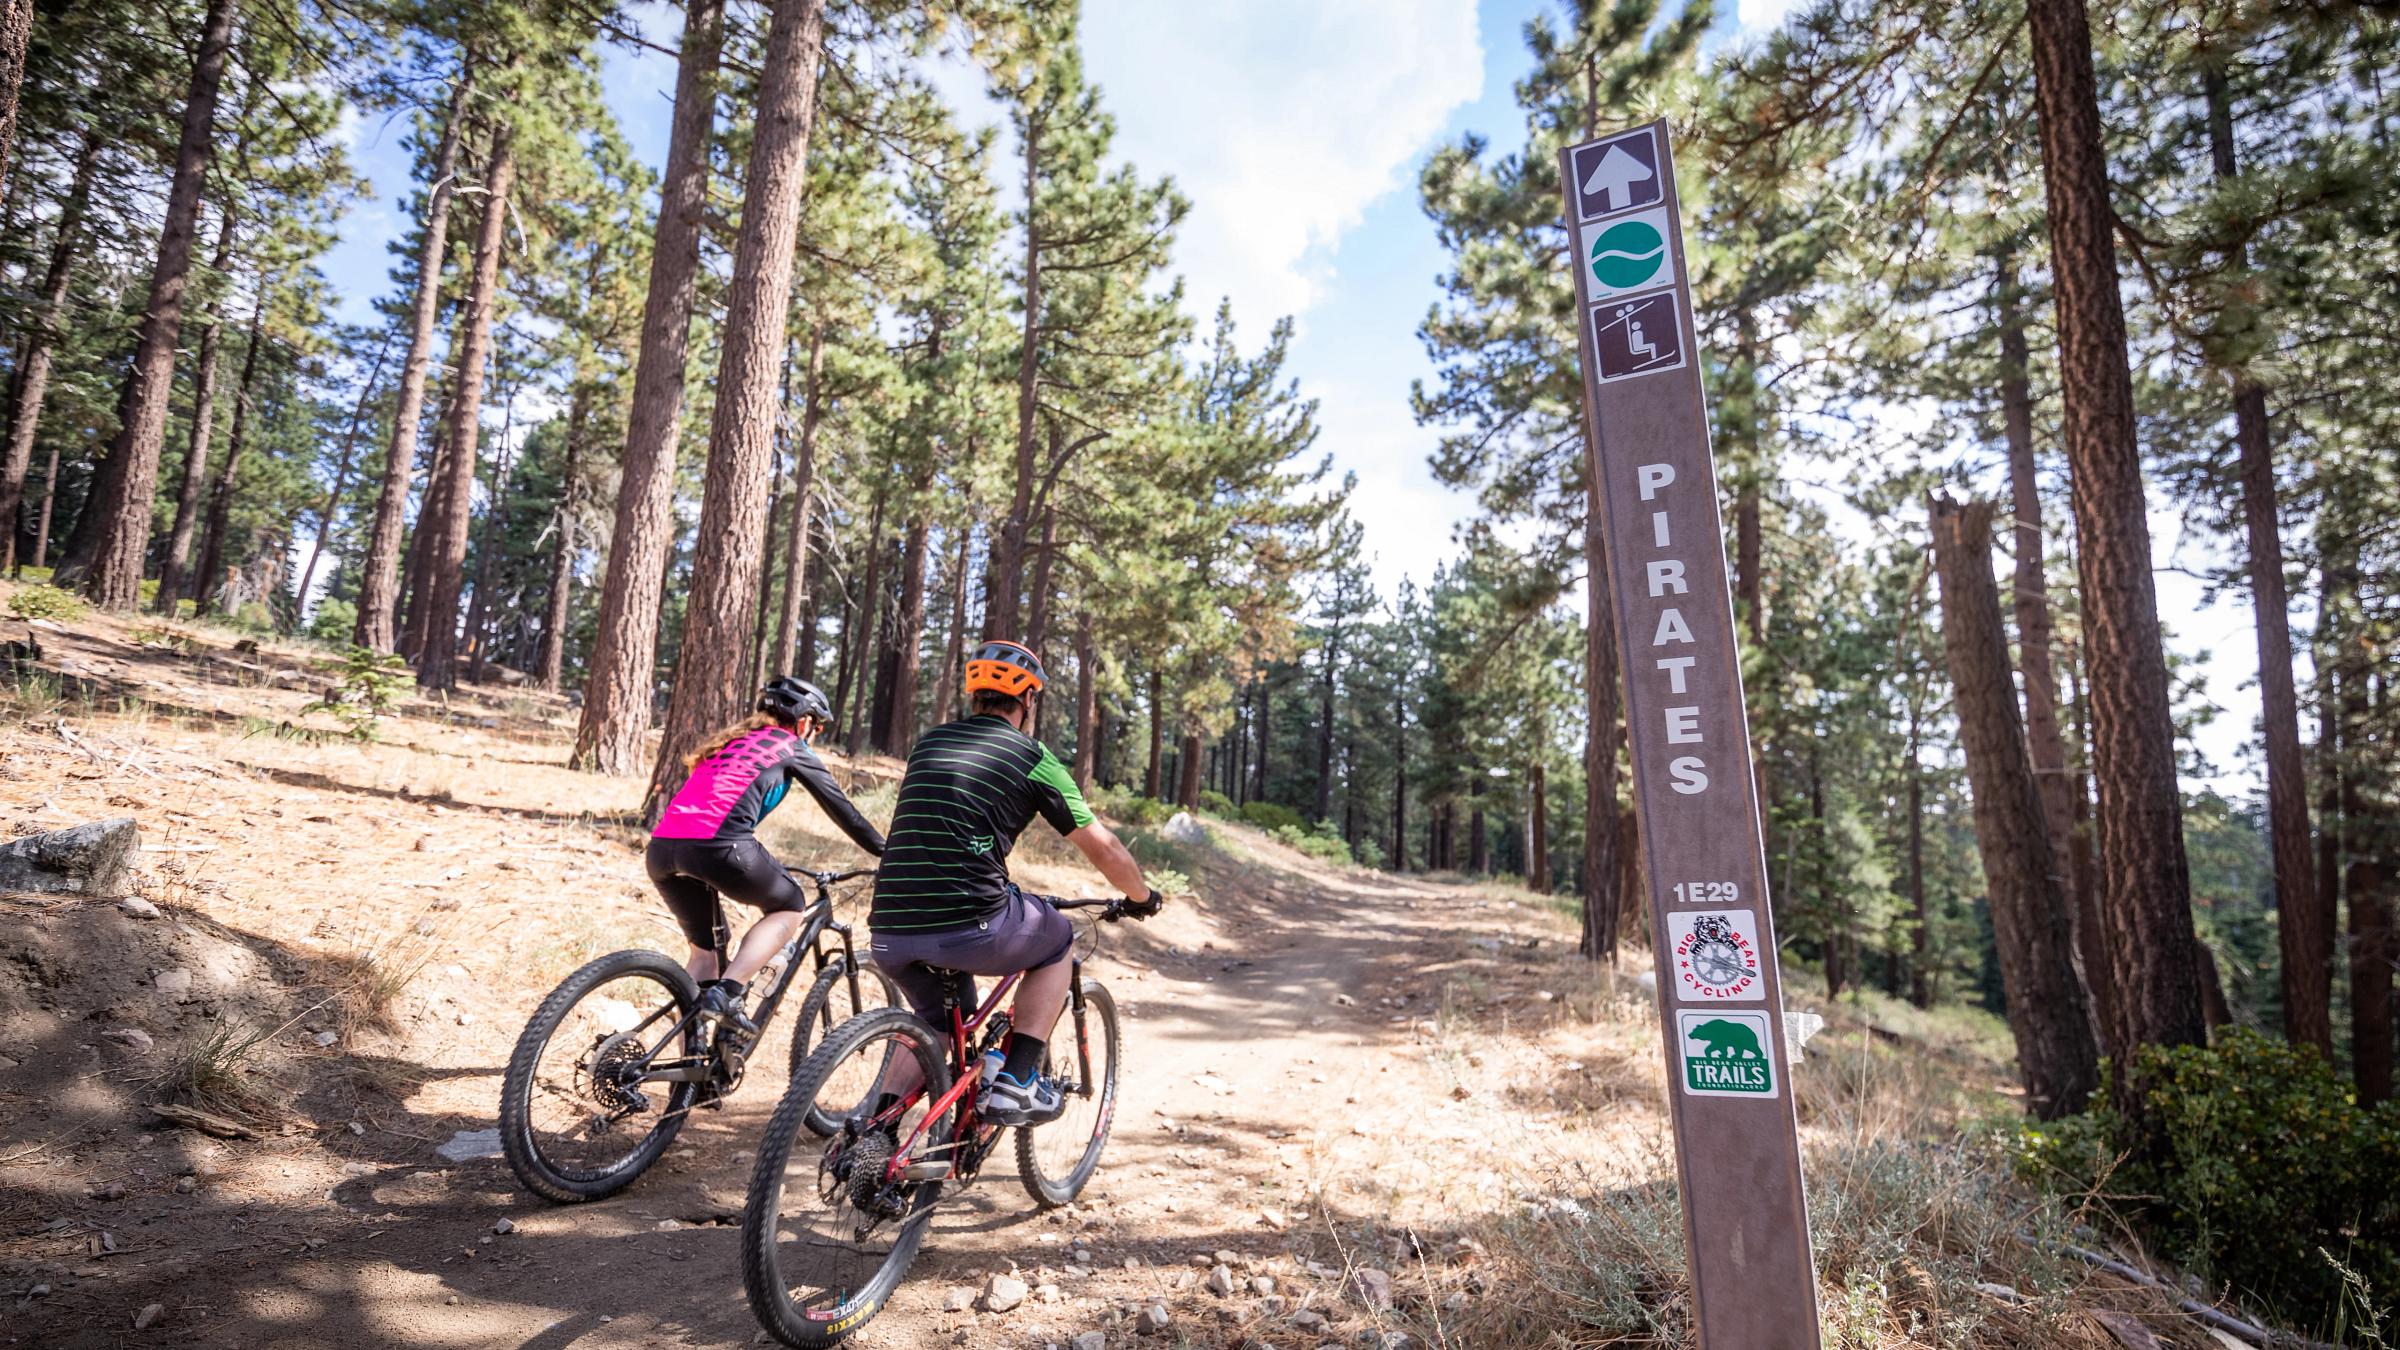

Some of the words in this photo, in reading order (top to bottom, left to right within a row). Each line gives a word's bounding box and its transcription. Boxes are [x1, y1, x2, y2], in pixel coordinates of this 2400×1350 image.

[1637, 463, 1709, 795] PIRATES
[1673, 881, 1739, 902] 1E29
[1677, 933, 1696, 956] BIG
[1730, 931, 1756, 968] BEAR
[1684, 973, 1752, 998] CYCLING
[1692, 1065, 1765, 1085] TRAILS
